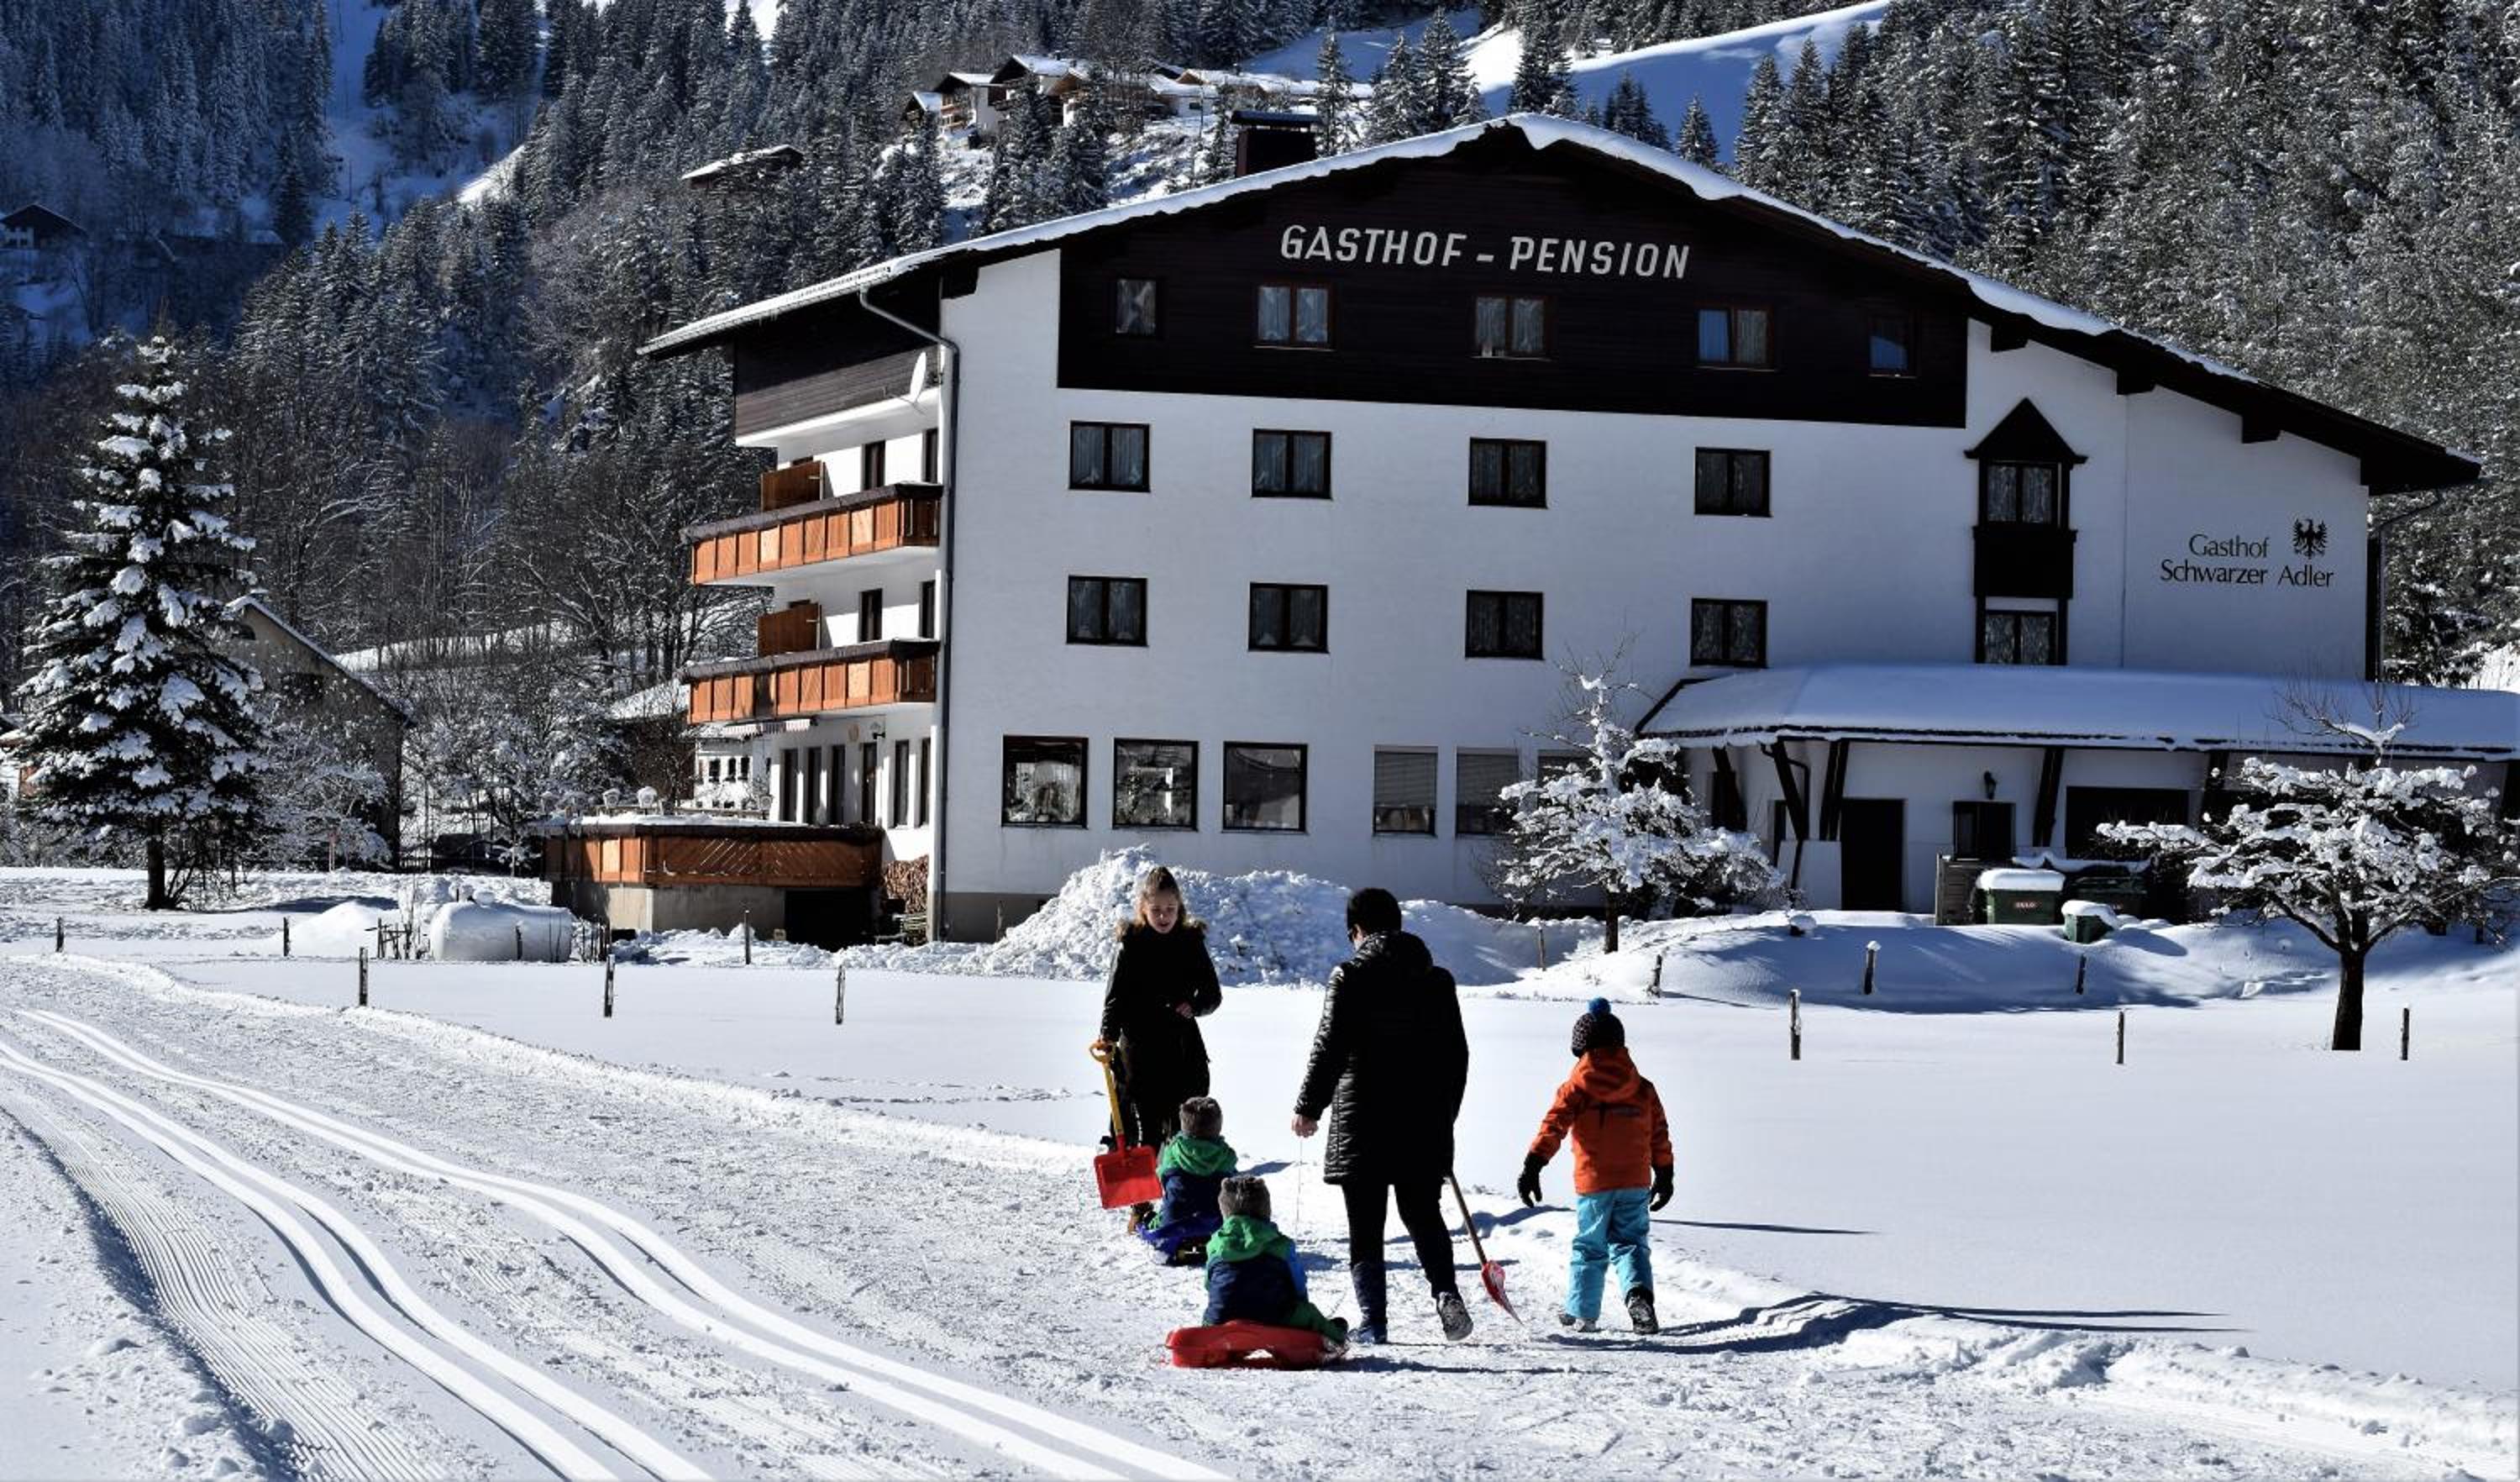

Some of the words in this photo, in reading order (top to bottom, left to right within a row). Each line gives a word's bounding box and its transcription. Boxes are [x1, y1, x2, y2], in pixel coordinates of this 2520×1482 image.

[1281, 225, 1467, 265] GASTHOF
[1510, 237, 1689, 279] PENSION
[2188, 533, 2270, 558] Gasthof
[2160, 559, 2268, 586] Schwarzer
[2277, 565, 2334, 588] Adler
